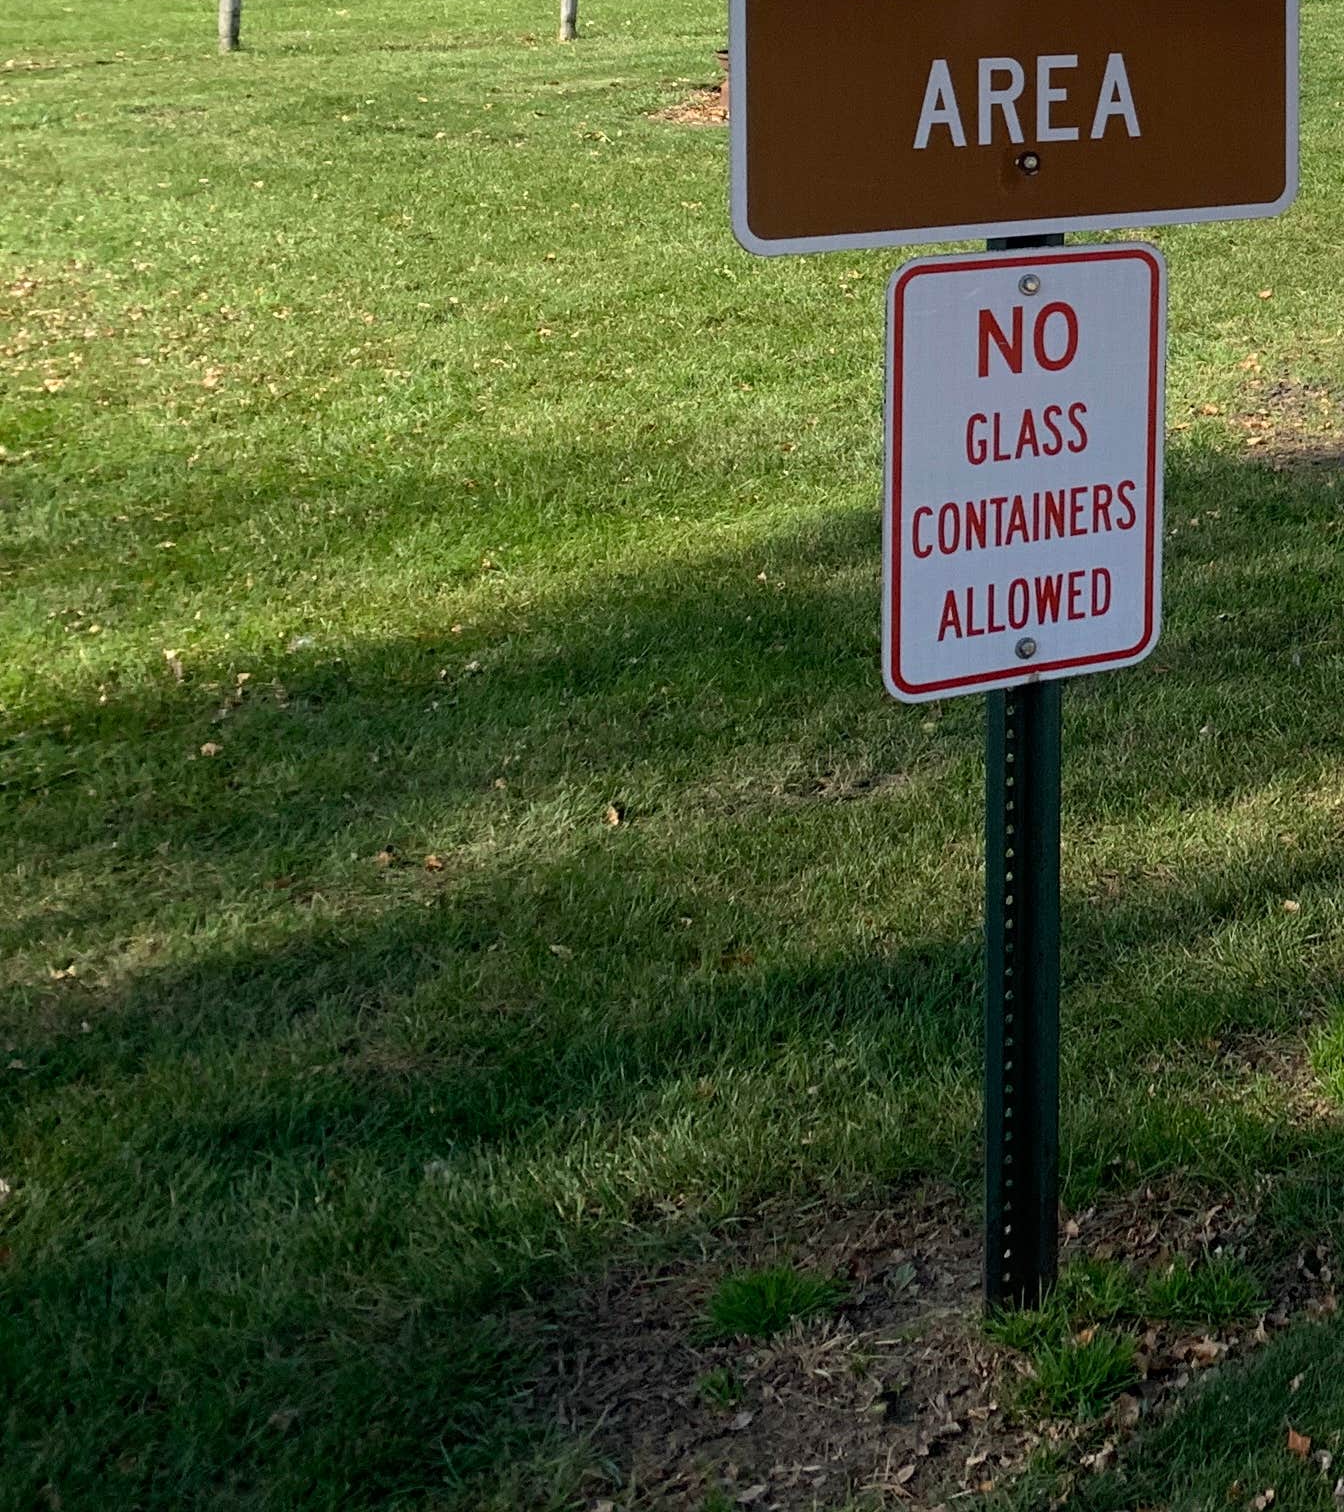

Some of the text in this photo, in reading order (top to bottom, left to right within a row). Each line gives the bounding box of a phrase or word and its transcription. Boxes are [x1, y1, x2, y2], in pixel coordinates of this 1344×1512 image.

[913, 52, 1141, 149] AREA
[978, 301, 1078, 378] NO
[966, 402, 1088, 465] GLASS
[912, 480, 1136, 559] CONTAINERS
[937, 567, 1111, 642] ALLOWED
